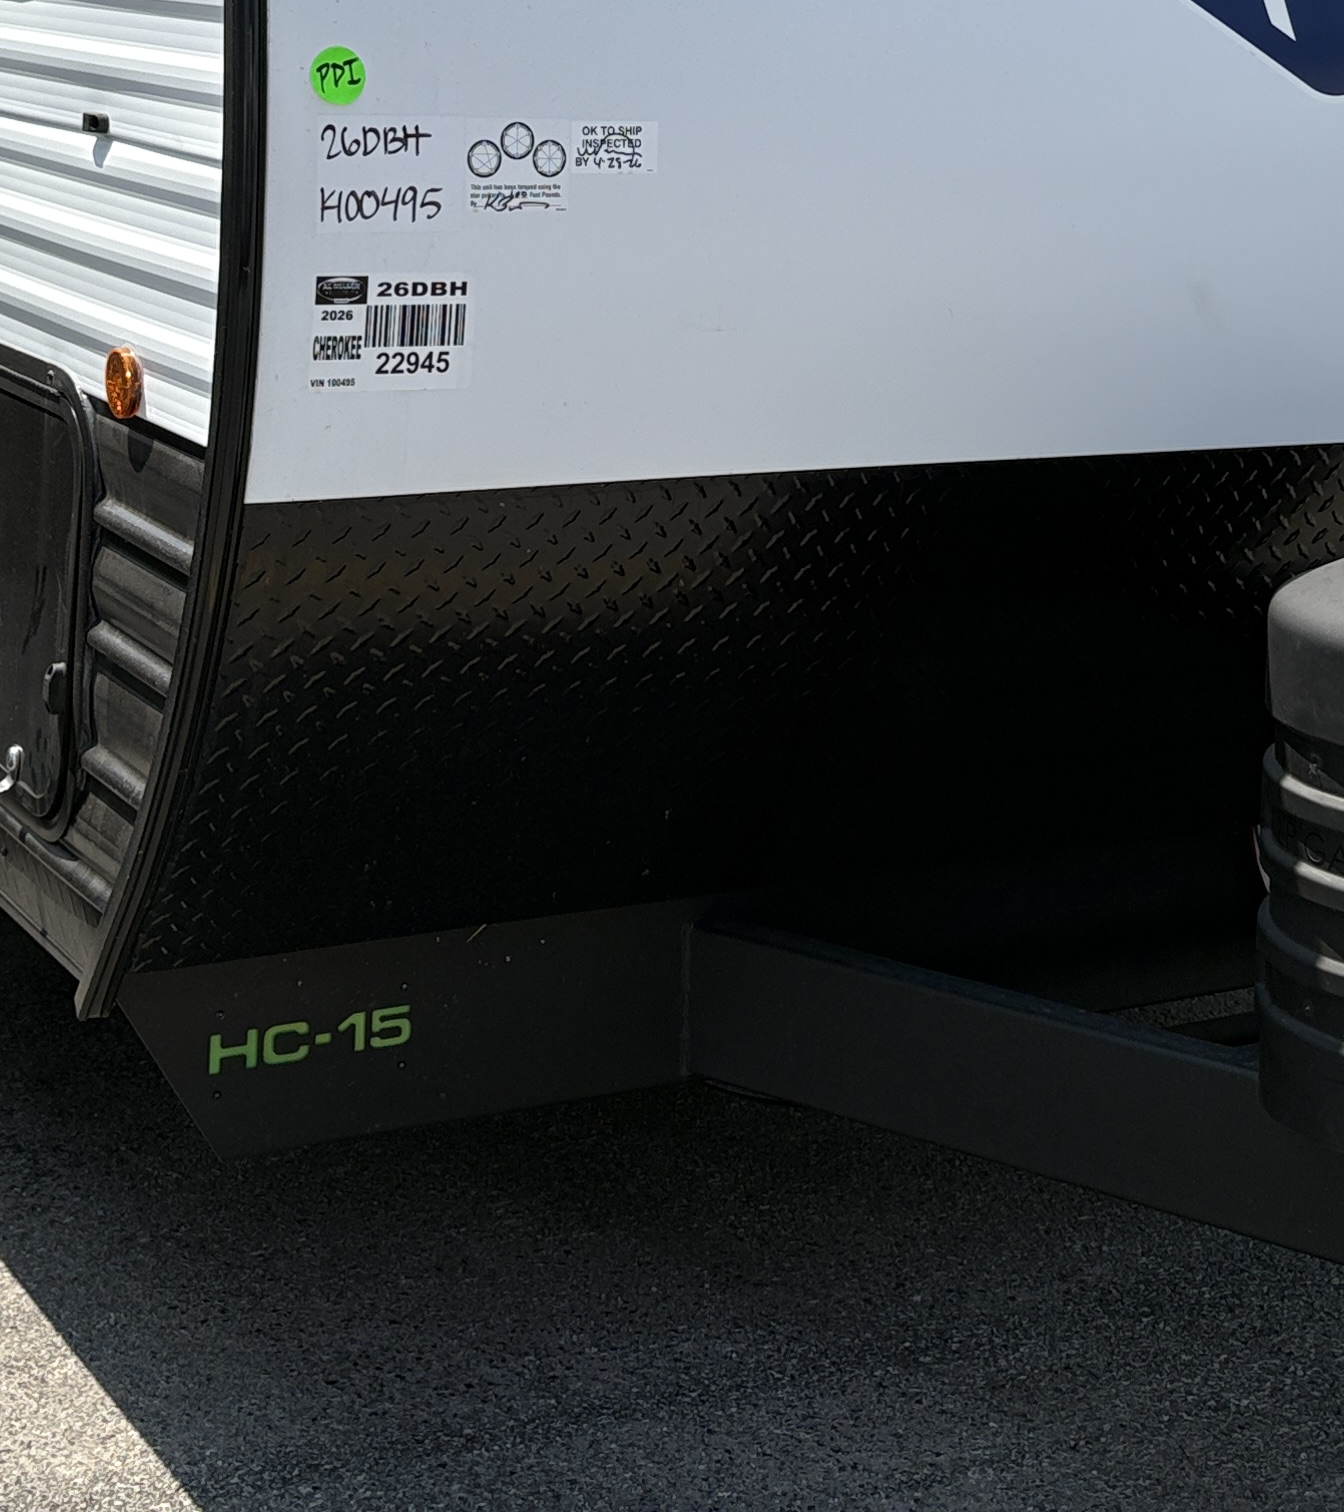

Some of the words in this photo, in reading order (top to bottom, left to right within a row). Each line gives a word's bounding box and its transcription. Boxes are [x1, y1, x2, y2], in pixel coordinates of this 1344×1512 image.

[316, 57, 362, 94] PDI
[582, 126, 598, 136] OK
[600, 126, 616, 136] TO
[618, 126, 643, 136] SHIP
[320, 124, 433, 160] 26DBH
[582, 139, 642, 149] INSPECTED
[575, 157, 589, 167] BY
[376, 281, 468, 297] 26DBH
[321, 310, 354, 321] 2026
[312, 336, 363, 361] CHEROKEE
[375, 351, 450, 374] 22945
[310, 379, 325, 387] VIN
[208, 1004, 412, 1075] HC-15
